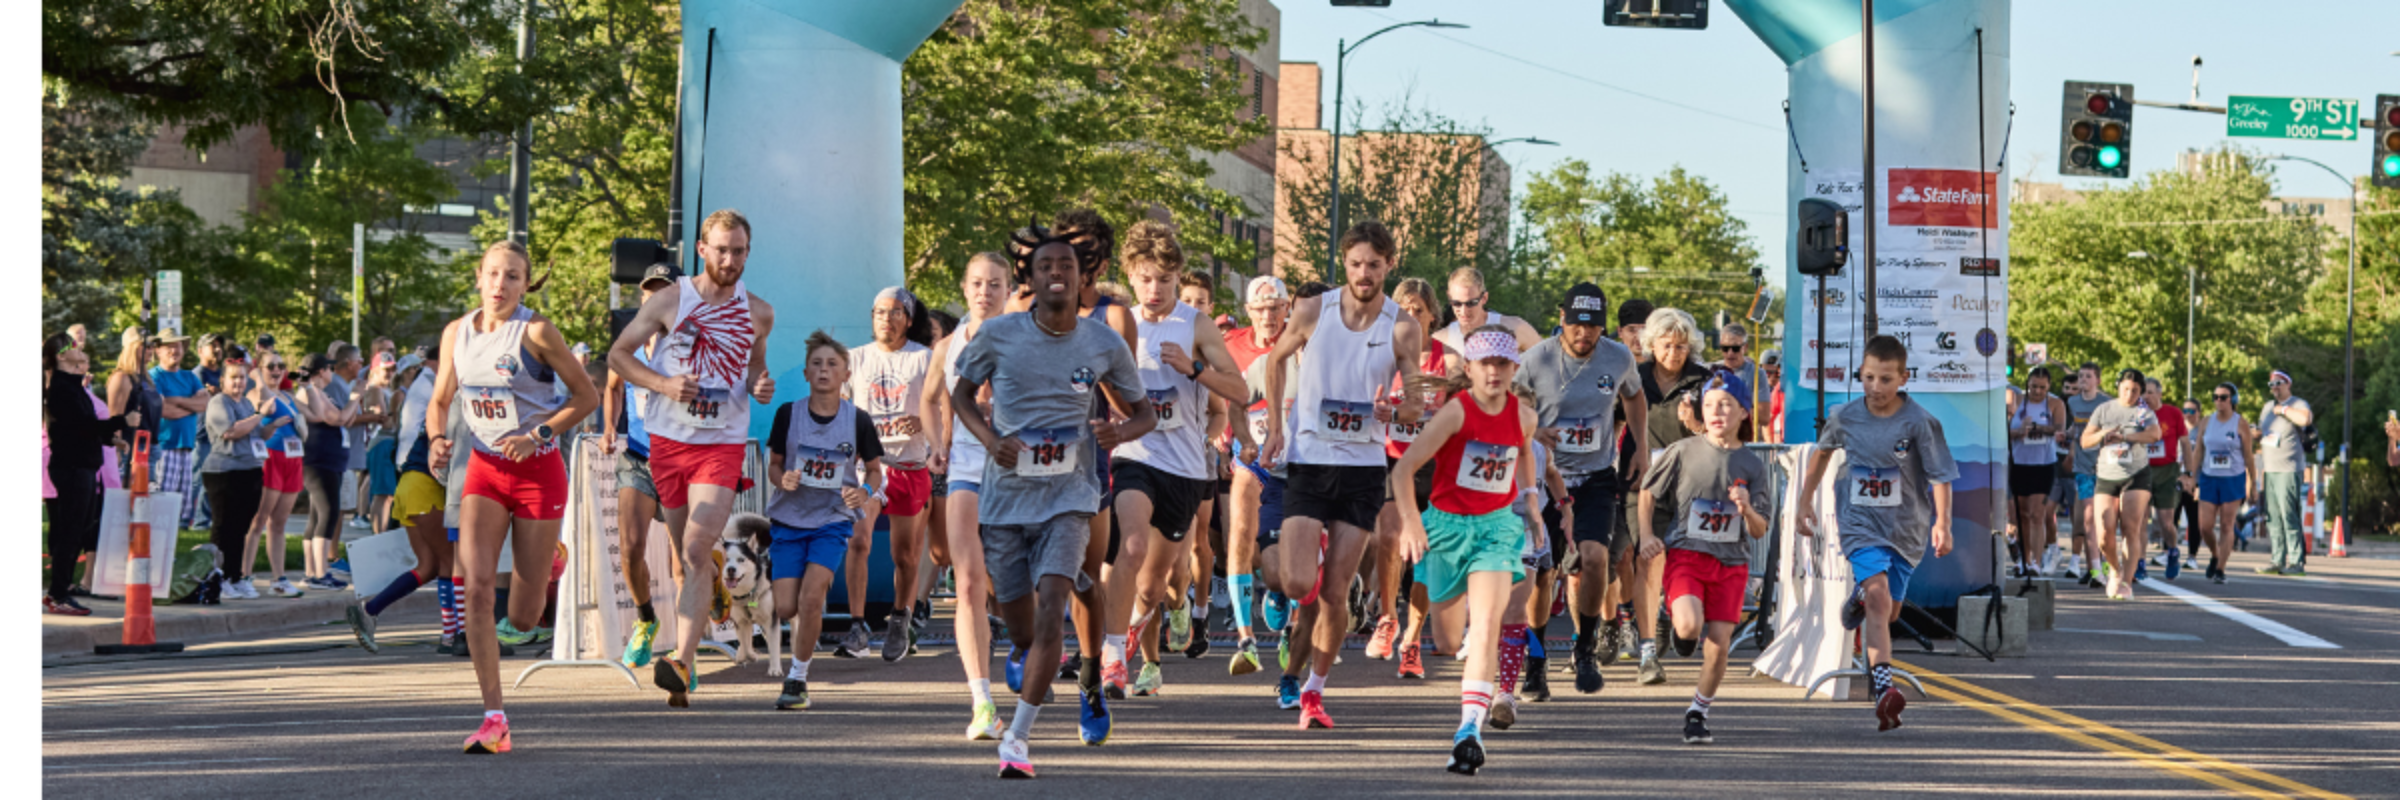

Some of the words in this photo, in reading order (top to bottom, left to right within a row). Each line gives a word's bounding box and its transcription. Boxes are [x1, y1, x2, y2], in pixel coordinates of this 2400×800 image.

[2290, 98, 2322, 123] 9TH
[2326, 100, 2357, 124] ST
[2229, 117, 2269, 132] Greeley
[2286, 124, 2319, 138] 1000
[471, 399, 508, 420] 065
[687, 399, 719, 418] 444
[1327, 411, 1363, 432] 325
[1565, 427, 1593, 445] 219
[1032, 442, 1065, 465] 134
[803, 458, 836, 480] 425
[1469, 455, 1507, 482] 235
[1858, 478, 1891, 498] 250
[1699, 512, 1732, 533] 237
